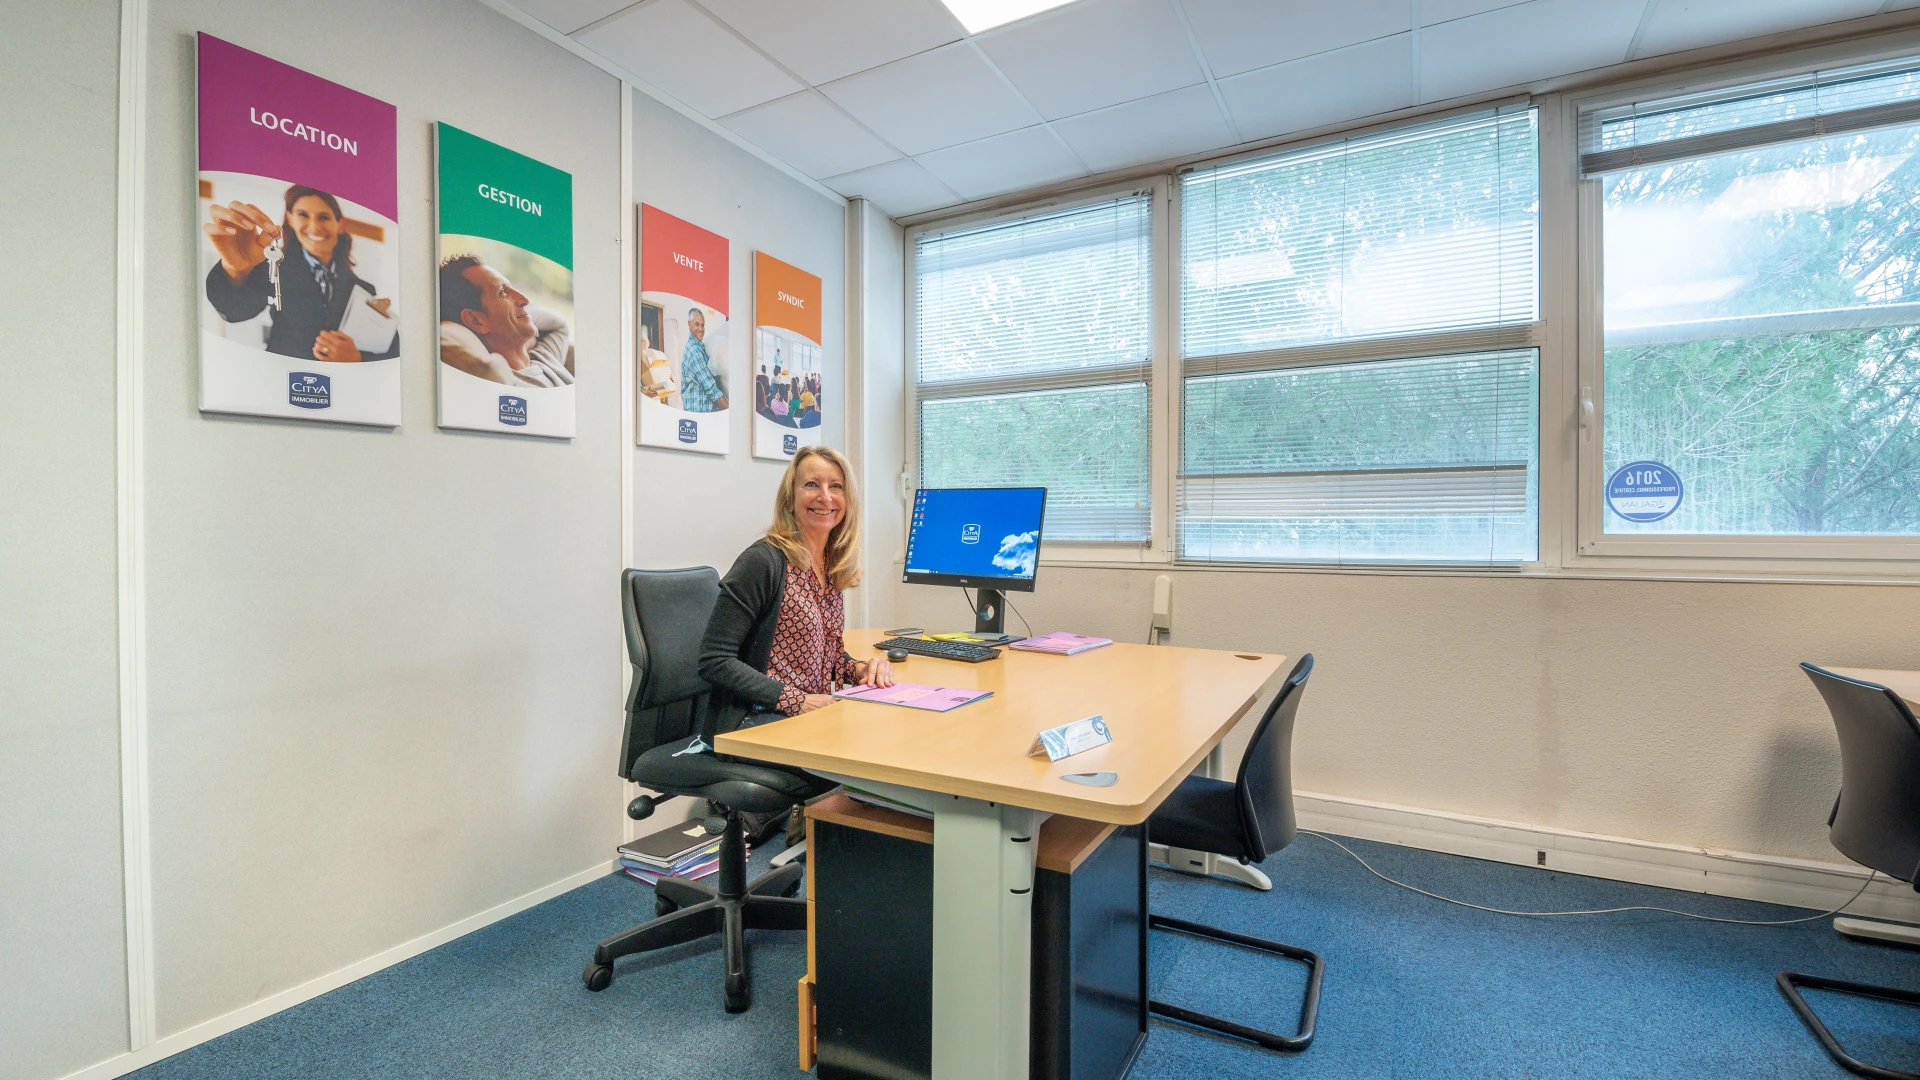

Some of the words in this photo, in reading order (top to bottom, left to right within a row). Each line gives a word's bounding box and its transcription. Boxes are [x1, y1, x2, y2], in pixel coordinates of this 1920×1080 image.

[249, 106, 358, 156] LOCATION
[478, 183, 542, 217] GESTION
[673, 251, 704, 273] VENTE
[777, 290, 805, 309] SYNDIC
[291, 382, 328, 394] CITYA
[291, 396, 329, 405] IMMOBILIER
